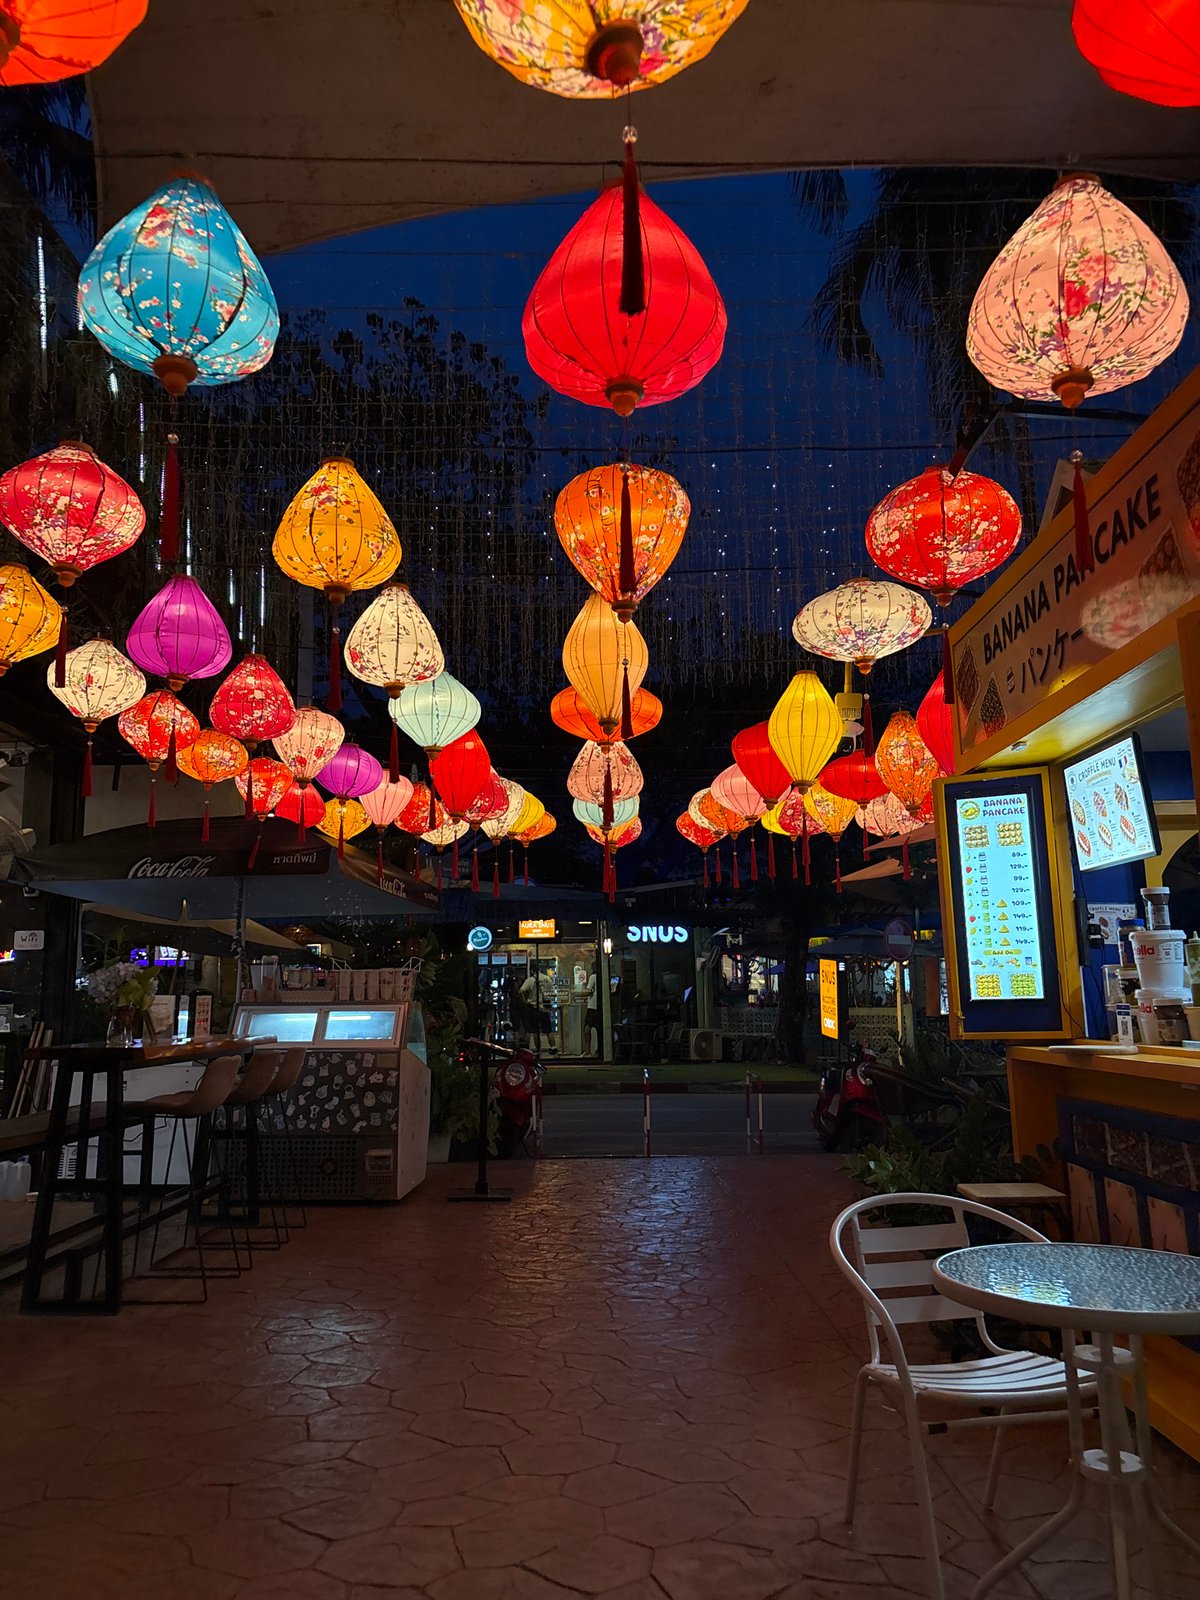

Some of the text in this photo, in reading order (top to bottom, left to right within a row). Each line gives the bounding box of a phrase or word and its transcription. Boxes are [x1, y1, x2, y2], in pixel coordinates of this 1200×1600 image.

[983, 473, 1162, 665] BANANA PACAKE
[1078, 762, 1100, 782] CROFFLE
[1100, 757, 1116, 770] MENU
[983, 797, 1022, 807] BANANA
[982, 807, 1026, 817] PANCAKE
[626, 925, 688, 943] SNUS
[822, 969, 836, 985] SNUS
